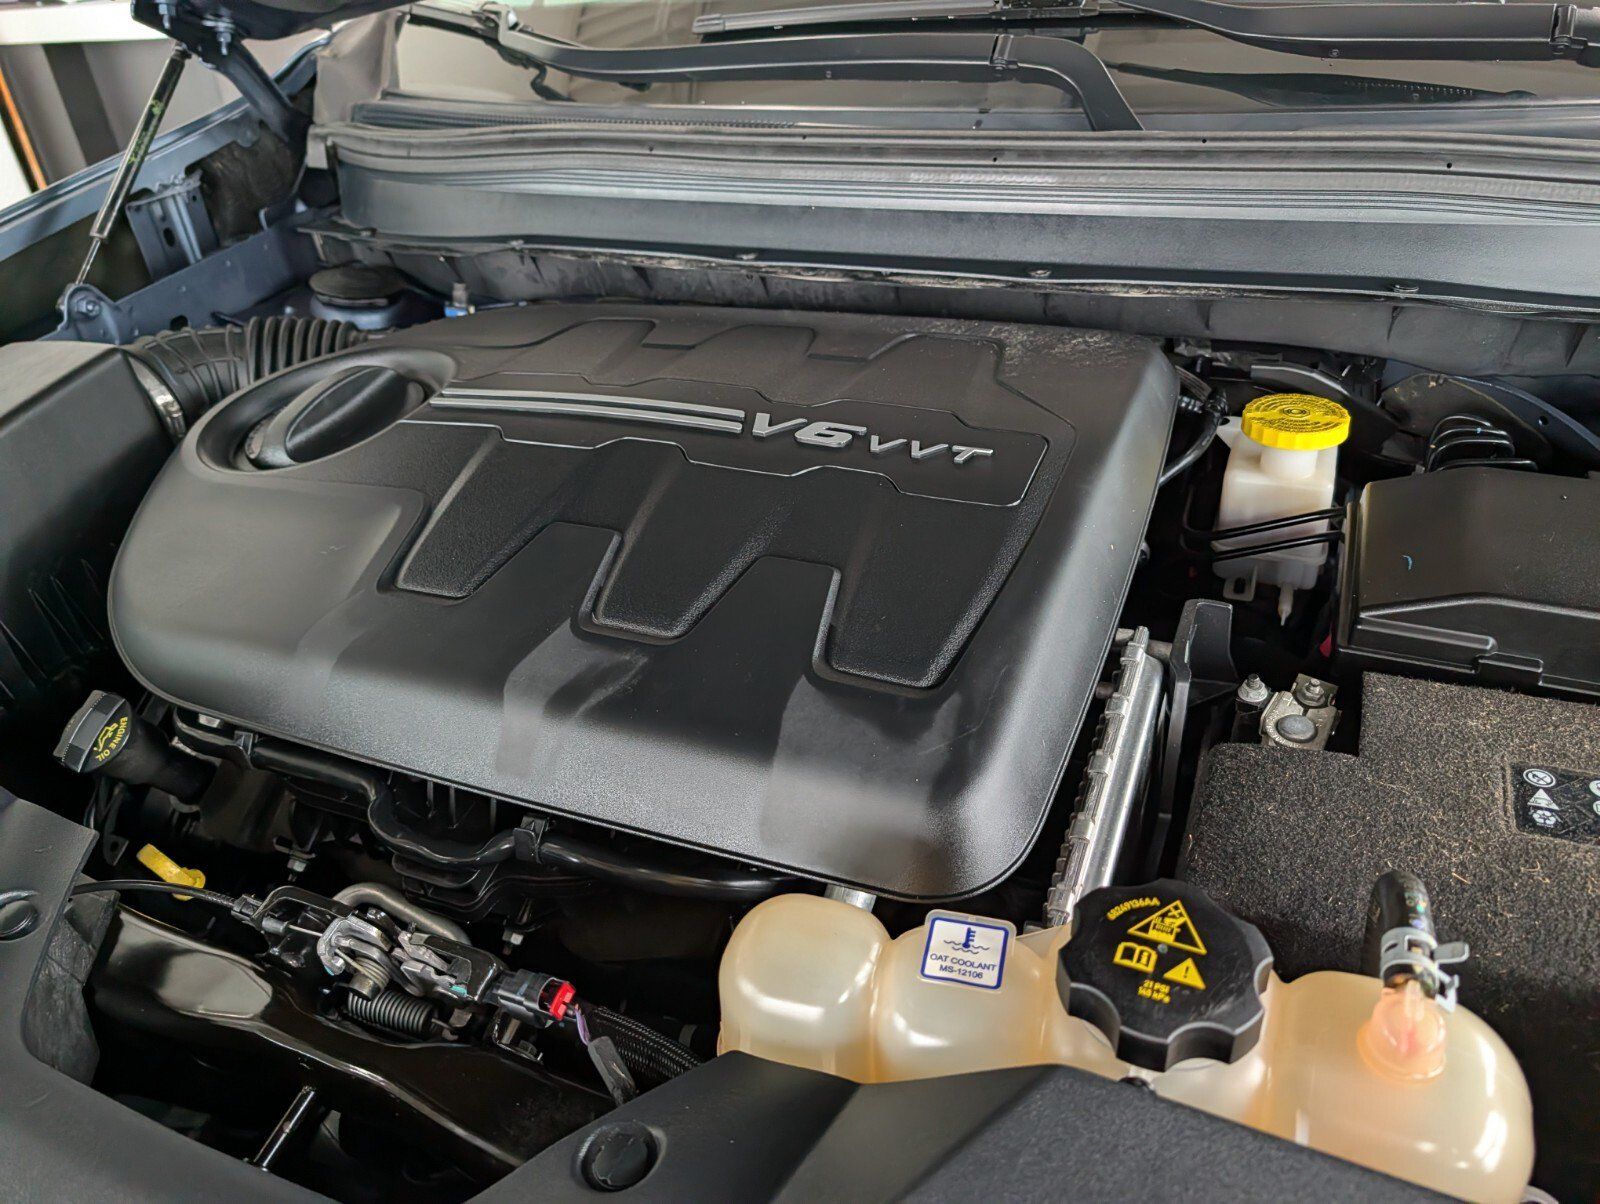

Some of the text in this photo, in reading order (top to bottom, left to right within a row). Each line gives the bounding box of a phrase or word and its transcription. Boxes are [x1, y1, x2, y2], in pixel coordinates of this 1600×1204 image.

[752, 412, 994, 464] V6 VVT
[95, 717, 128, 761] ENGINE OIL
[930, 953, 997, 971] OAT COOLANT
[939, 964, 984, 979] MS-12106
